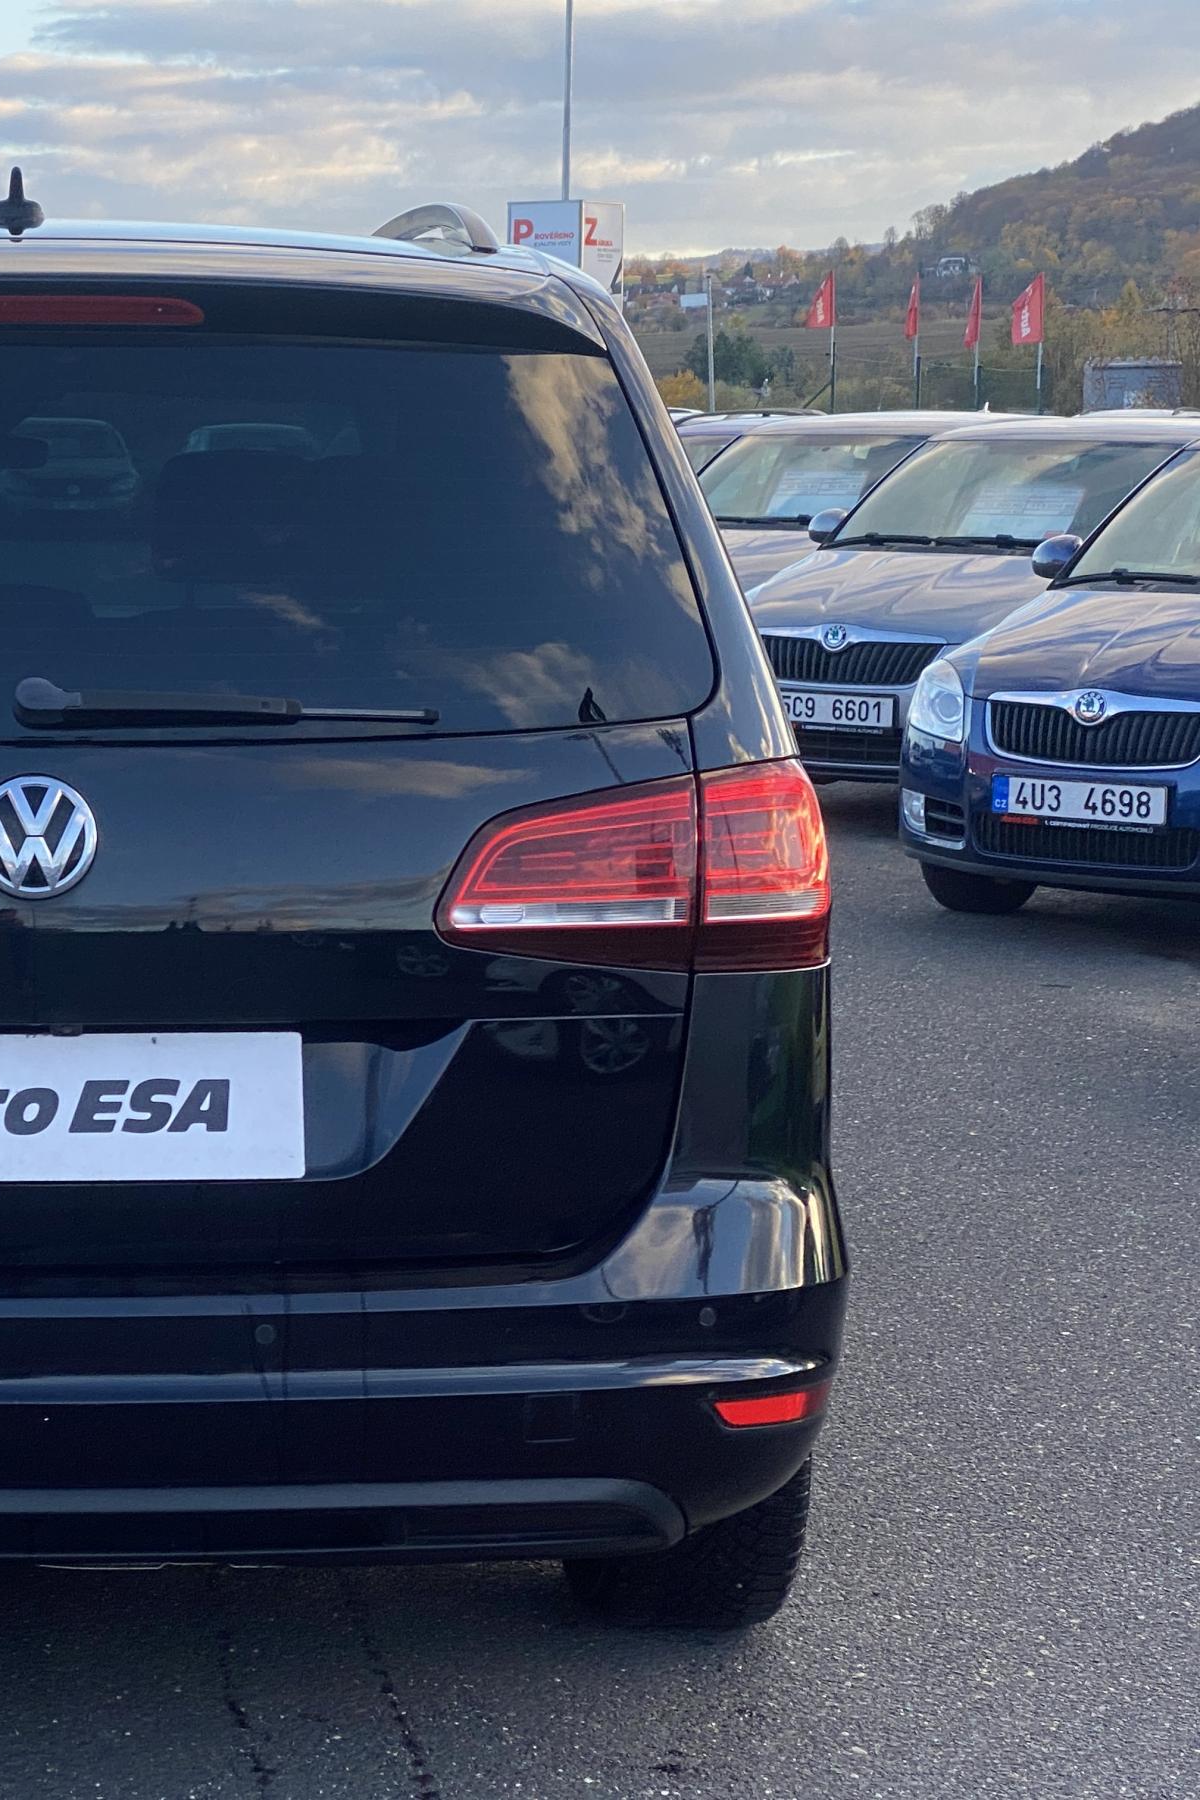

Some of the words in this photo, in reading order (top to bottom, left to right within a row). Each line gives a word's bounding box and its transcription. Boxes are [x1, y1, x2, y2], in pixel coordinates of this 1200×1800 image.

[832, 698, 881, 723] 6601
[994, 799, 1007, 808] CZ
[1014, 782, 1062, 812] 4U3
[1083, 787, 1151, 818] 4698
[68, 1078, 231, 1134] ESA
